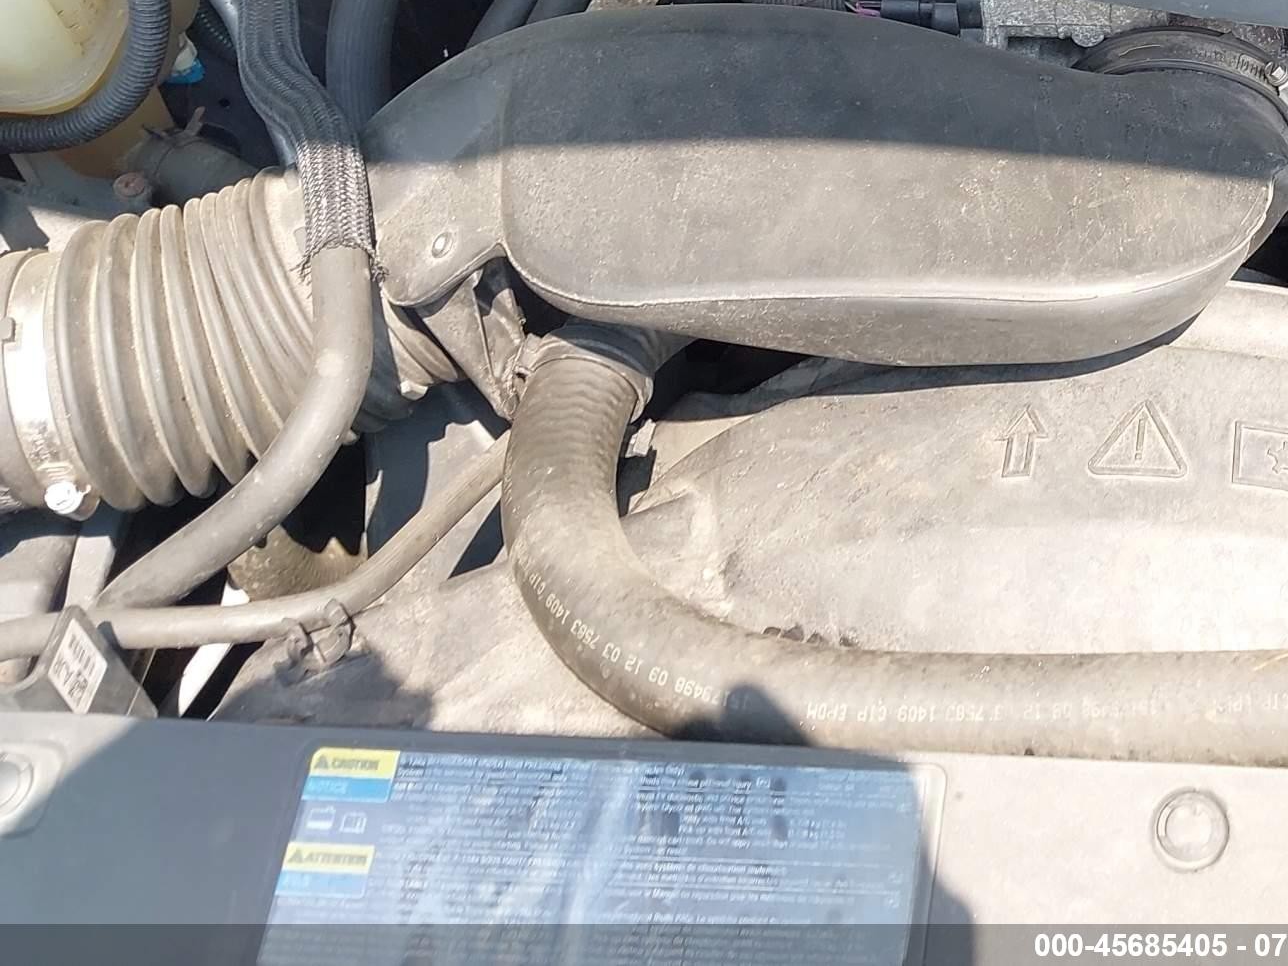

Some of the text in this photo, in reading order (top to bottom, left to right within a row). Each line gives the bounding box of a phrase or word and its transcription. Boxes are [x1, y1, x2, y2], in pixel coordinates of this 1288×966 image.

[545, 593, 571, 625] 1409
[602, 642, 621, 663] 03
[624, 654, 644, 675] 12
[648, 666, 669, 686] 09
[806, 701, 848, 722] EPDM
[896, 704, 936, 722] 1409
[331, 758, 380, 770] CAUTION
[305, 852, 369, 866] ATTENTION
